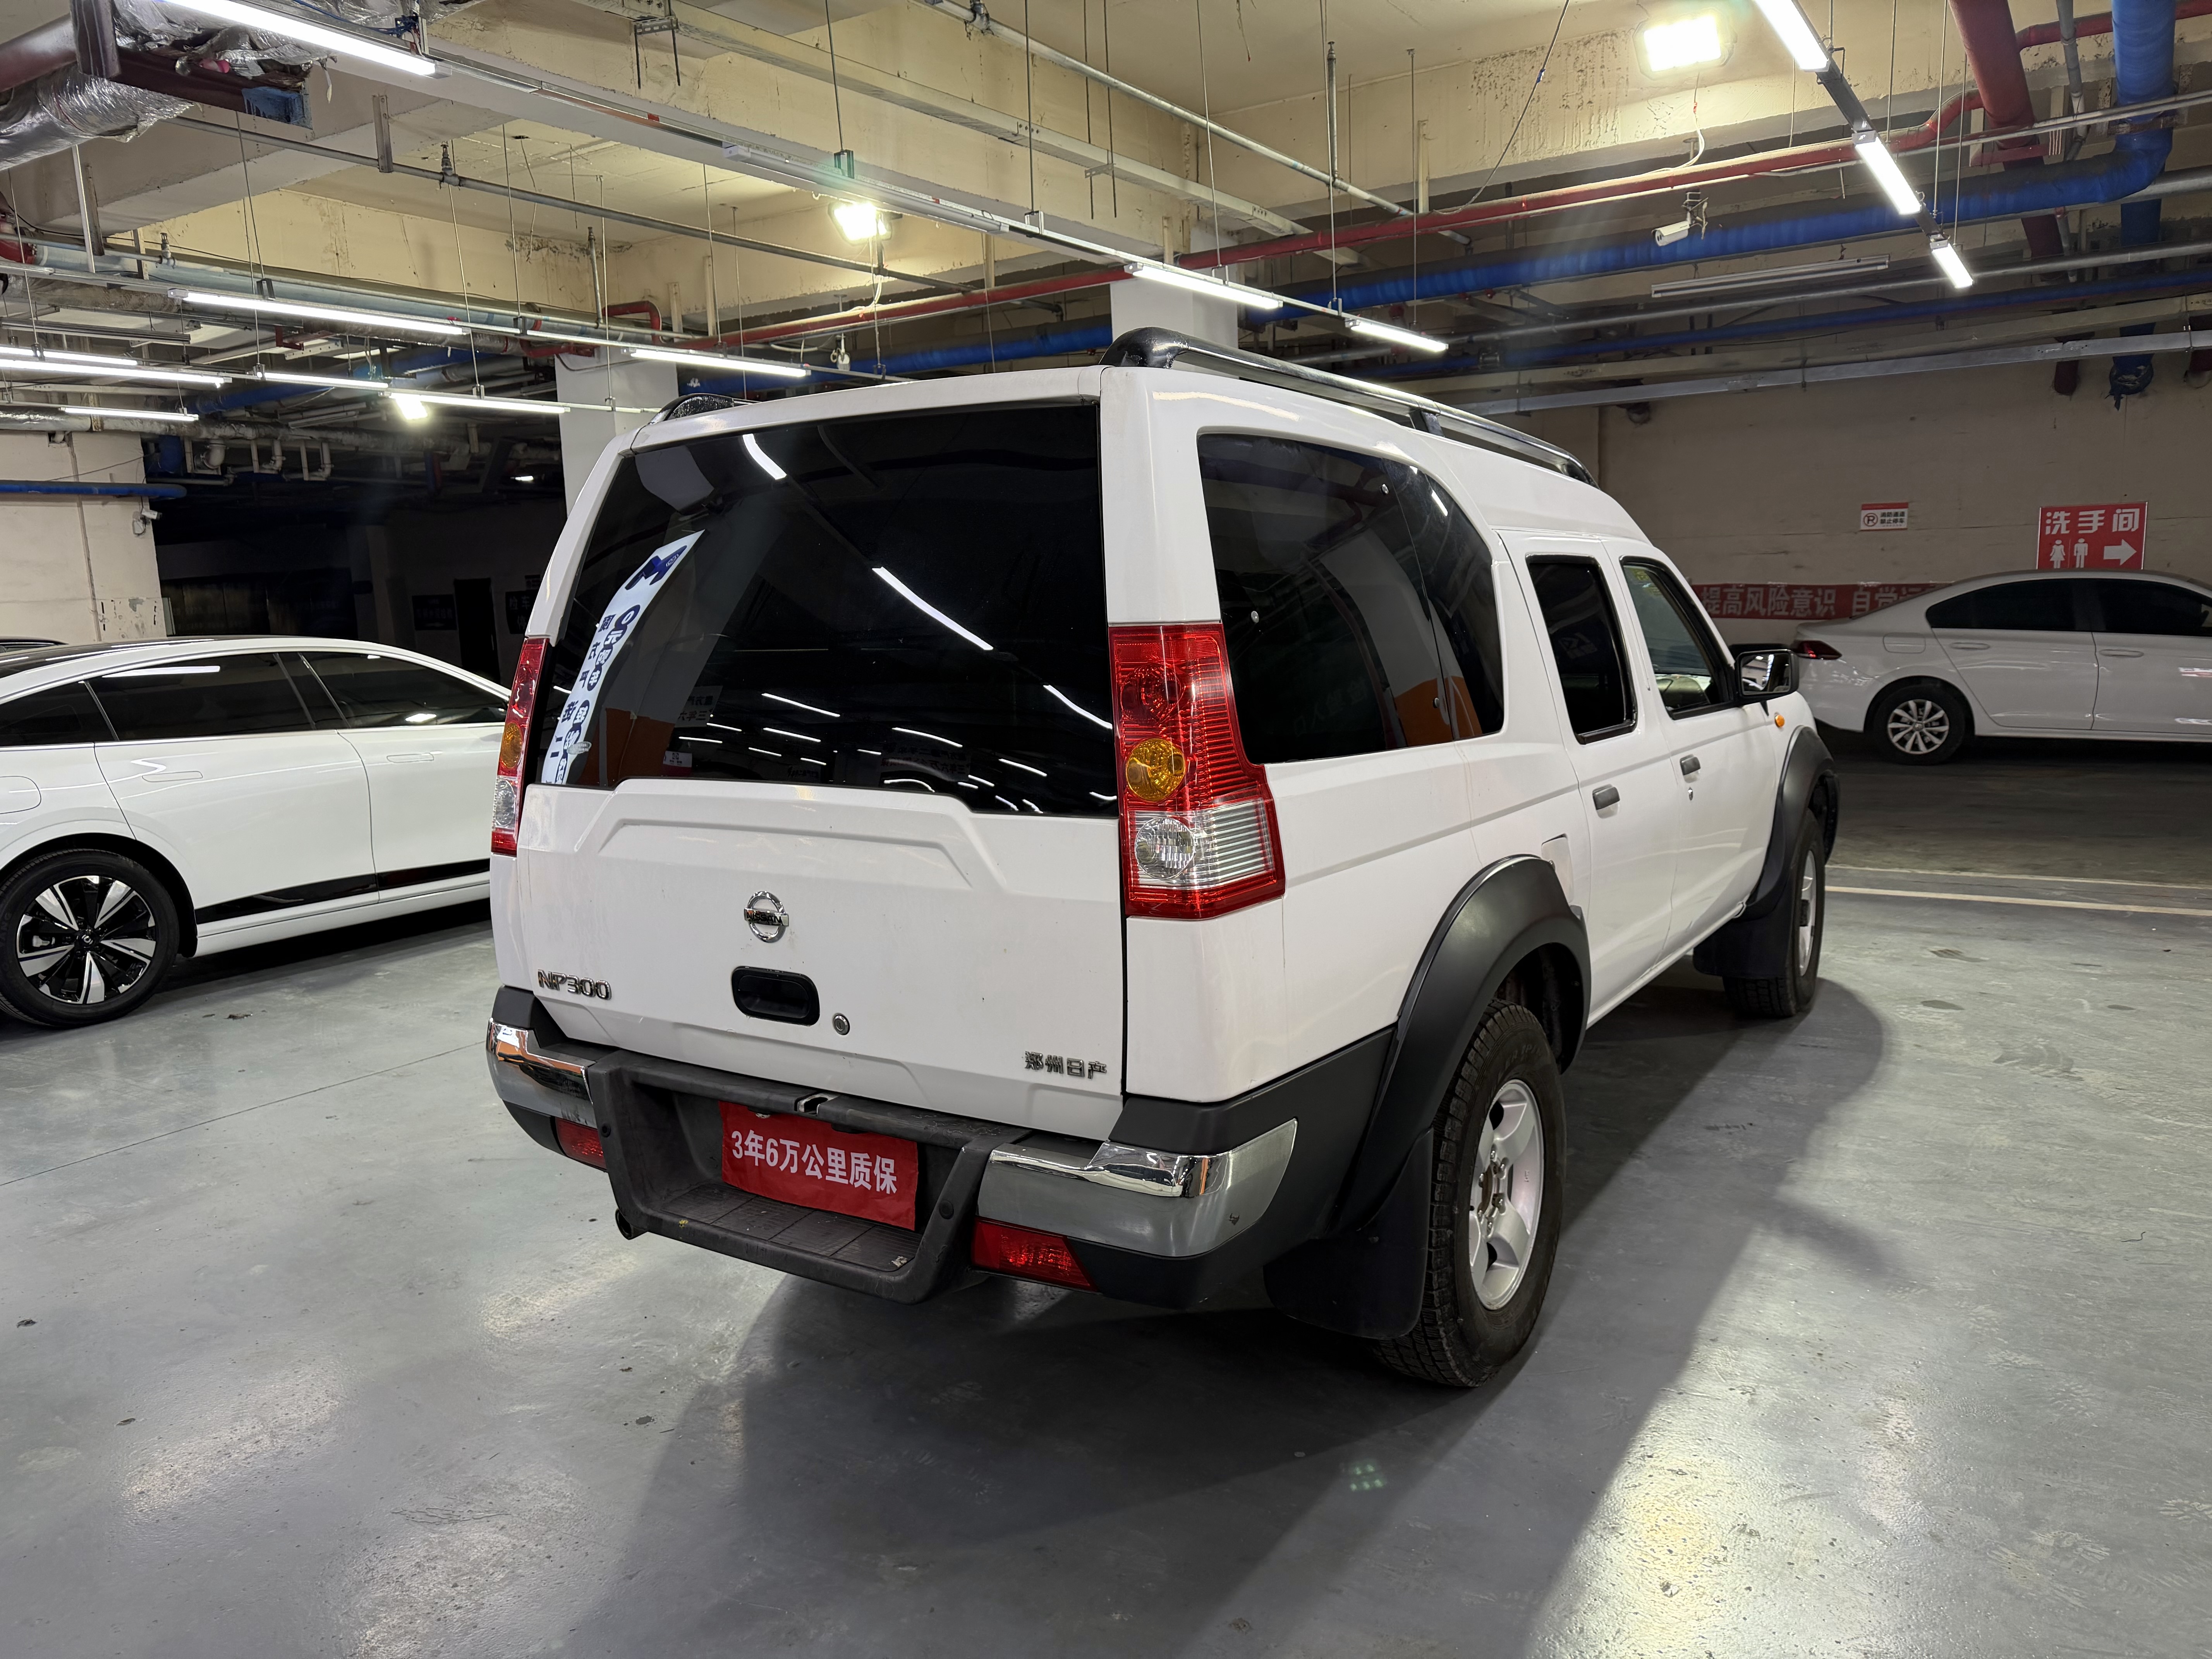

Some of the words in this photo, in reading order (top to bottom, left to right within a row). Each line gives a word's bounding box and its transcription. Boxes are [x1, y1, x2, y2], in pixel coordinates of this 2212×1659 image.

[2045, 508, 2140, 535] 洗手间
[1701, 585, 1836, 616] 提高风险意识
[1852, 585, 1922, 615] 自觉
[746, 910, 782, 923] NISSAN
[538, 969, 612, 1000] NP300
[1025, 1051, 1107, 1079] 郑州日产
[732, 1130, 897, 1194] 3年6万公里质保
